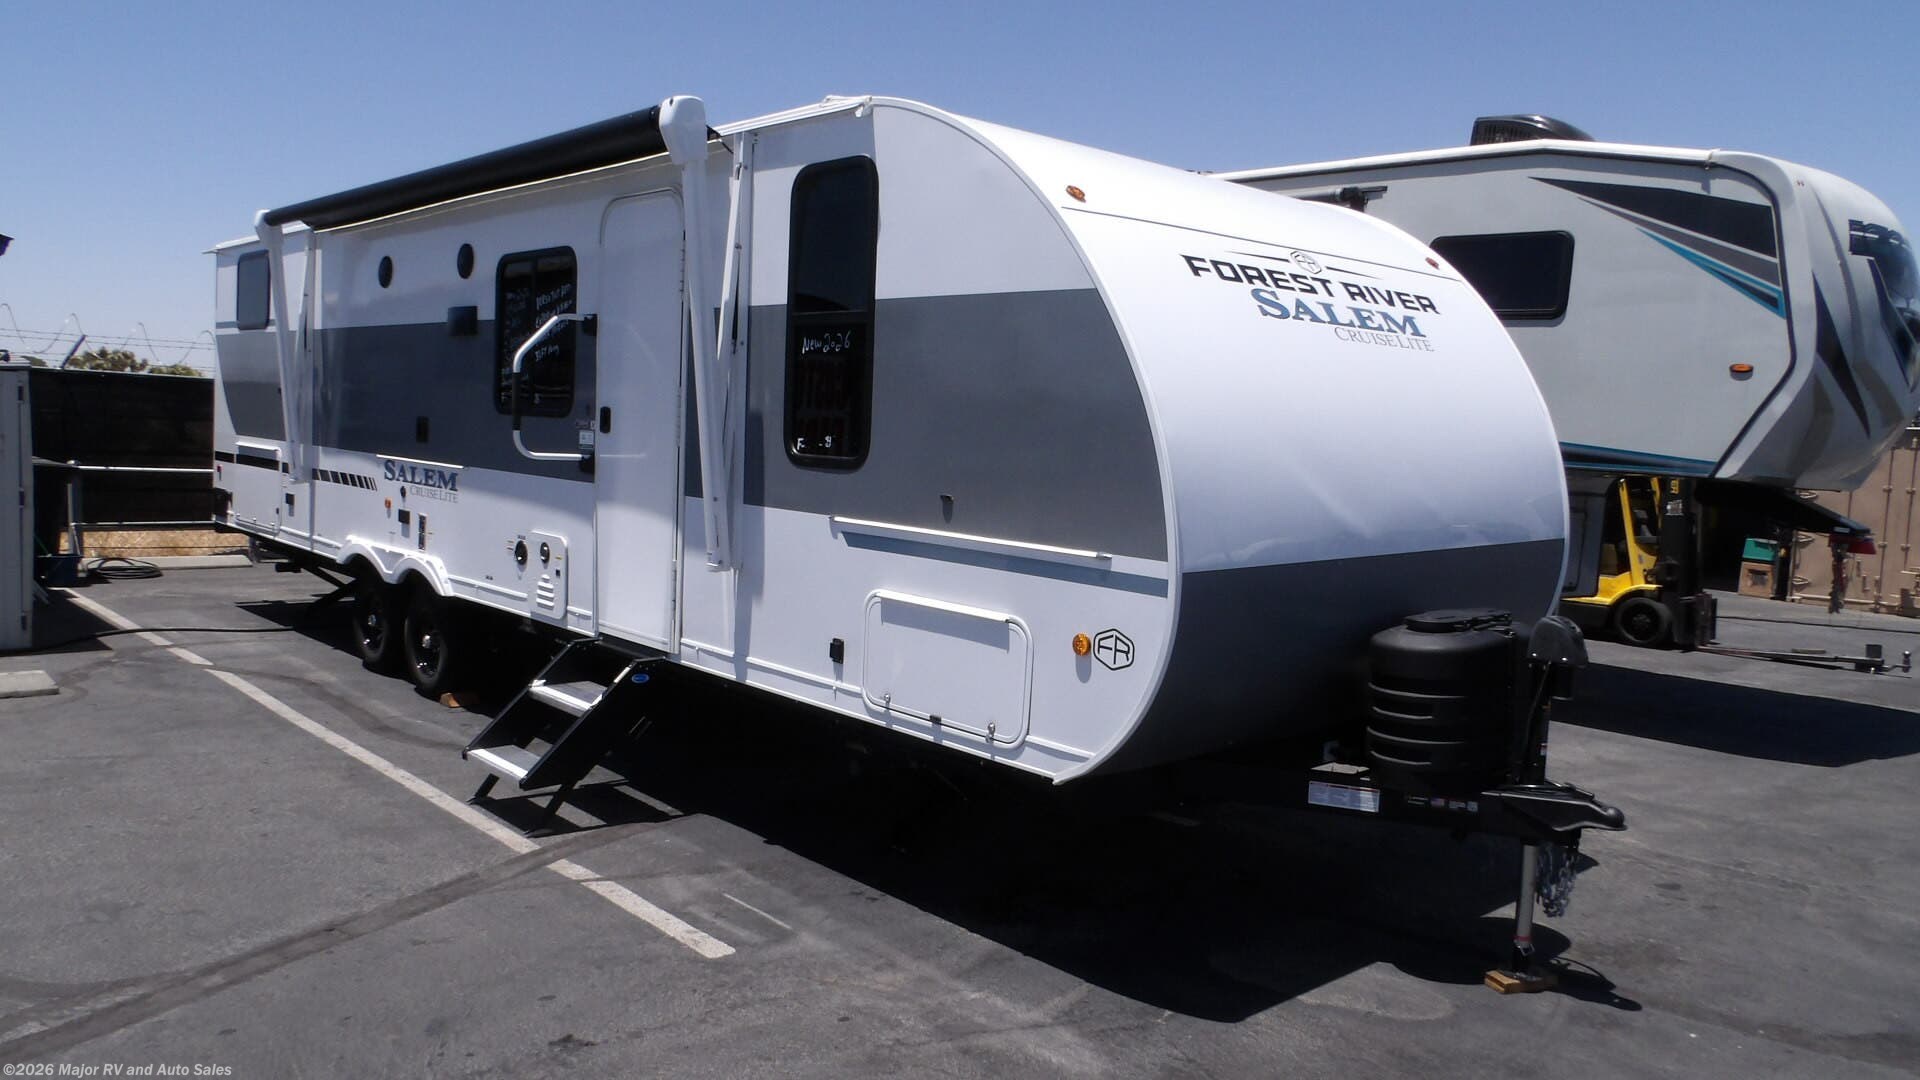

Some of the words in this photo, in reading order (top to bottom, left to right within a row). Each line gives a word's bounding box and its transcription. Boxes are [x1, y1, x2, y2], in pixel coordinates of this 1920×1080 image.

[1179, 253, 1335, 298] FOREST
[1338, 280, 1441, 315] RIVER
[1250, 287, 1427, 338] SALEM
[384, 459, 459, 492] SALEM
